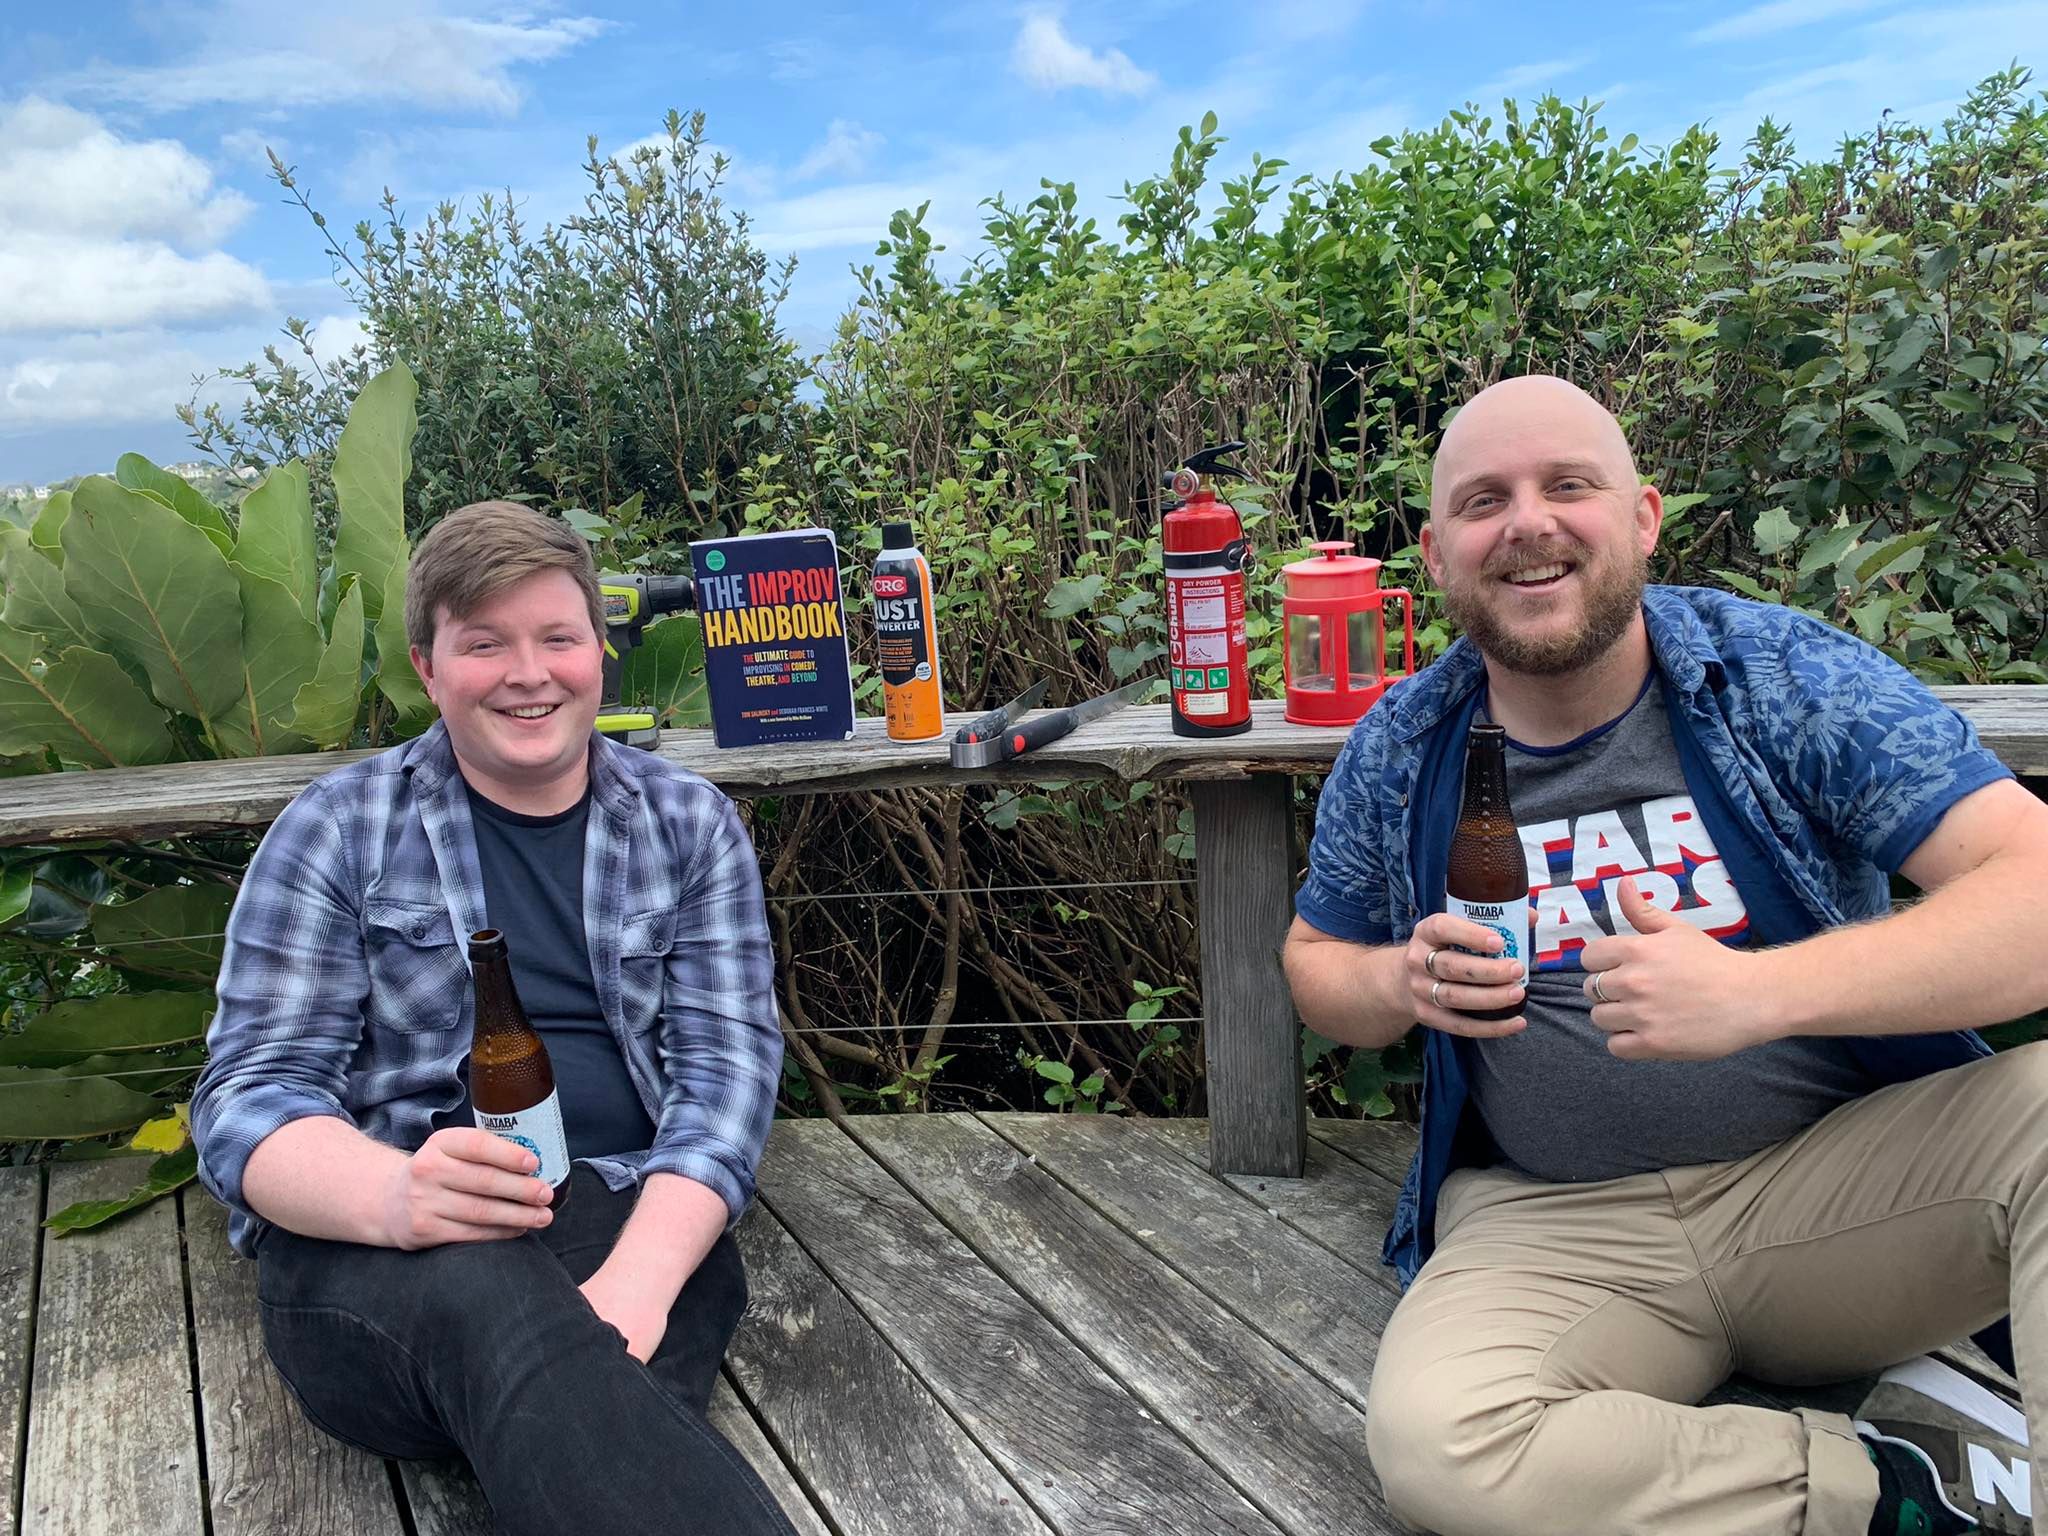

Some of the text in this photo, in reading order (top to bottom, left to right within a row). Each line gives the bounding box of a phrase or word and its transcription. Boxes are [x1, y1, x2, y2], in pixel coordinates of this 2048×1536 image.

[699, 567, 834, 611] THE IMPROV
[874, 580, 905, 592] CRC
[1196, 578, 1222, 587] POWDER
[704, 601, 842, 648] HANDBOOK
[743, 649, 815, 663] THE ULTIMATE GUIDE TO
[743, 663, 784, 675] IMPROVISING
[783, 662, 790, 672] IN
[745, 671, 818, 687] THEATRE, AND BEYOND
[1517, 796, 1719, 888] TAR
[1463, 904, 1504, 916] TUATARA
[1535, 859, 1747, 952] ARS
[480, 1115, 518, 1128] TUATARA
[1967, 1442, 2032, 1518] N
